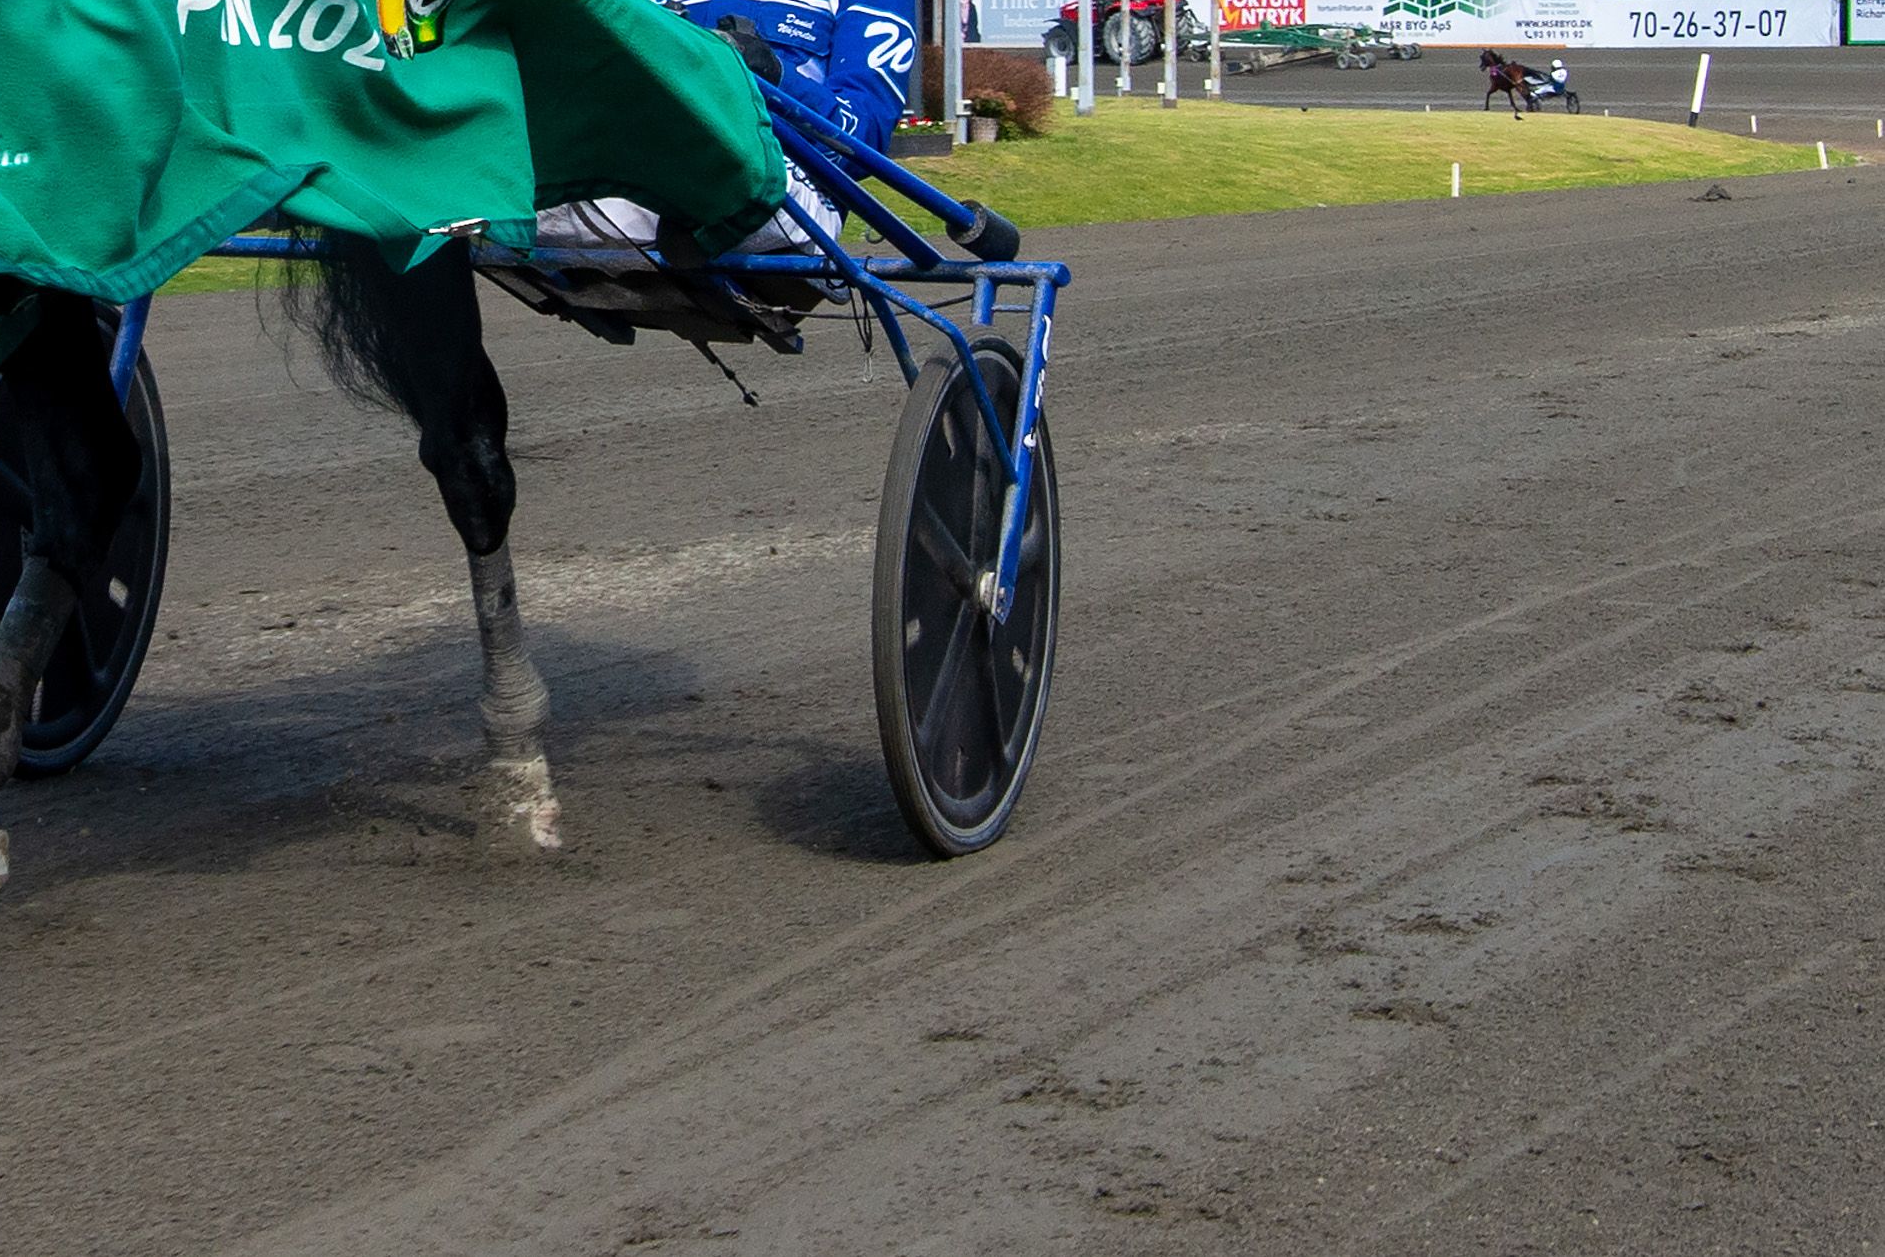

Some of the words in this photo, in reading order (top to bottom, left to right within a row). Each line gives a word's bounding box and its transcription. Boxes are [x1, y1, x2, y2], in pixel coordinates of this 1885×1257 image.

[1405, 20, 1428, 31] BYG
[1430, 20, 1452, 33] ApS
[1515, 19, 1593, 29] WWW.MSRBYG.DK
[1629, 9, 1788, 39] 70-26-37-07
